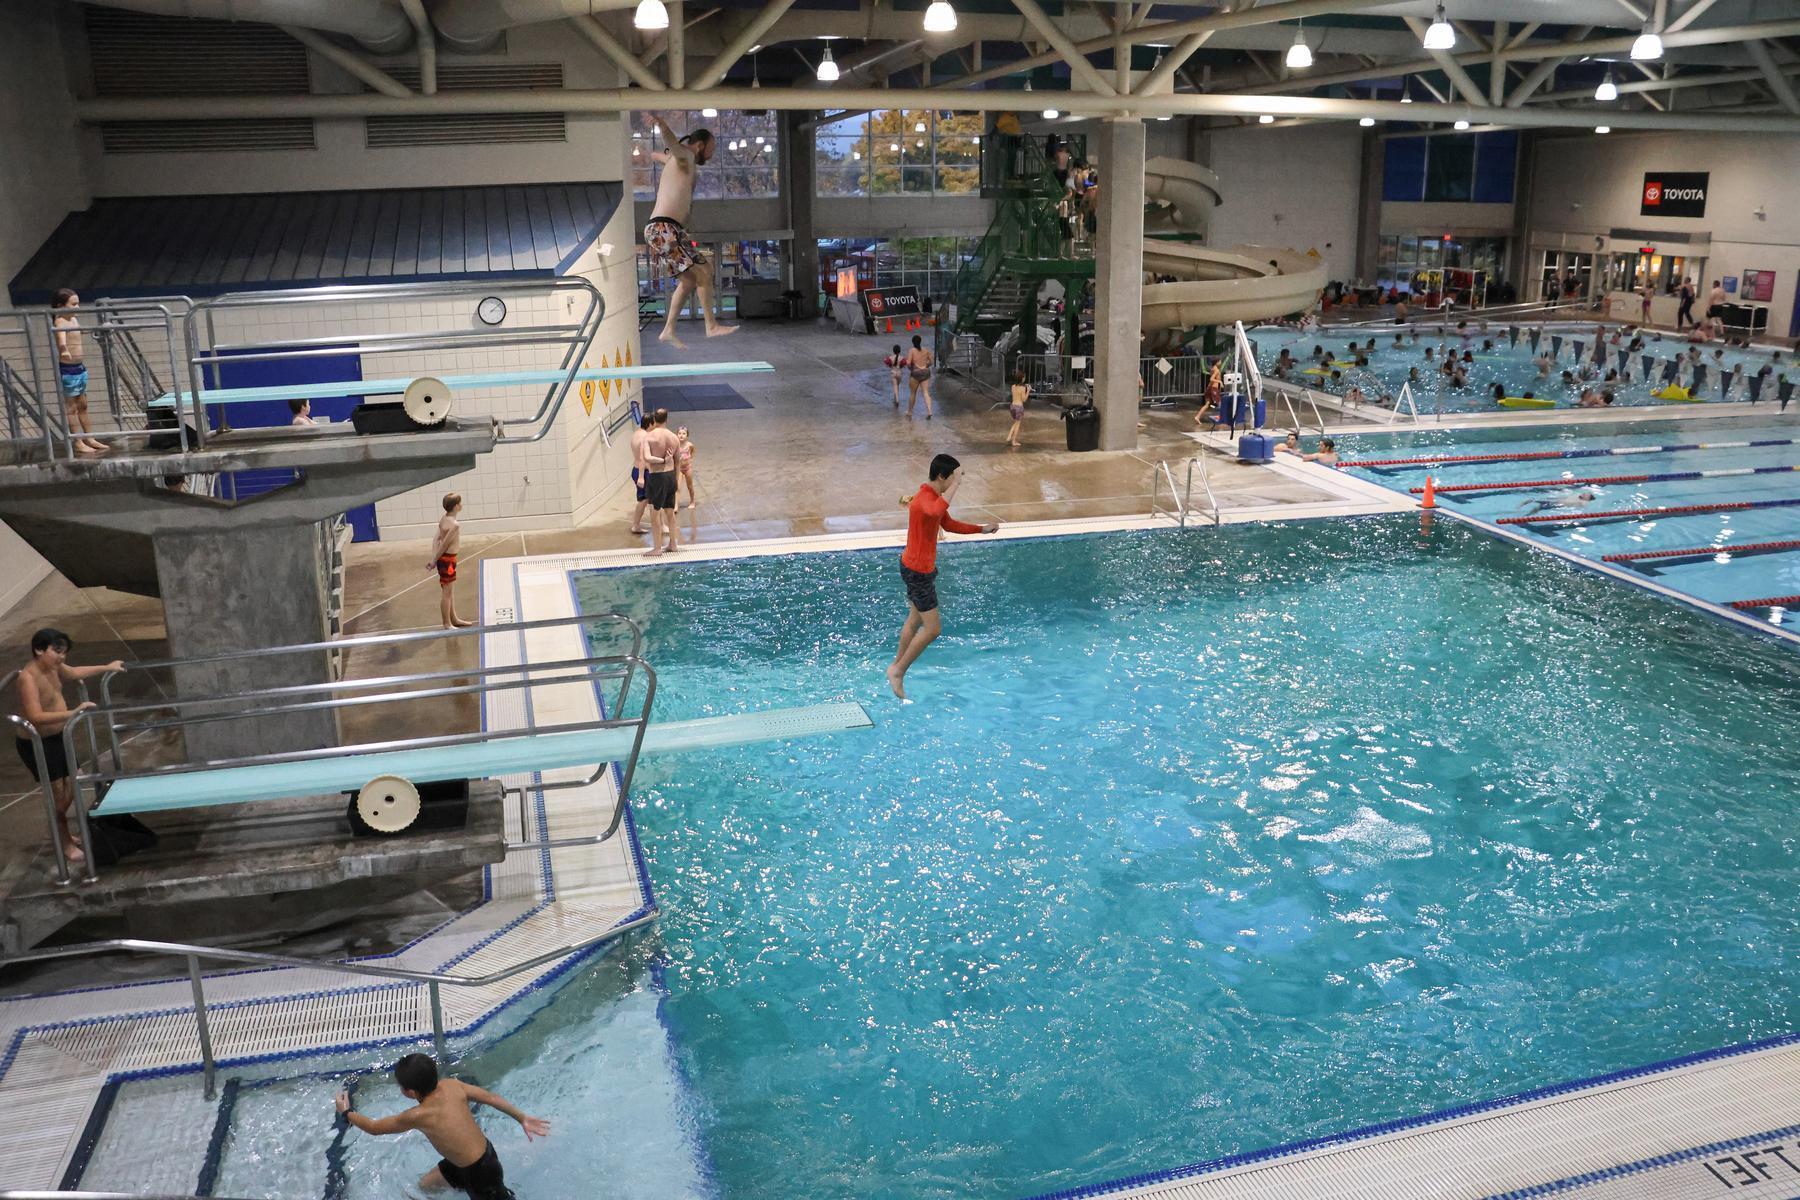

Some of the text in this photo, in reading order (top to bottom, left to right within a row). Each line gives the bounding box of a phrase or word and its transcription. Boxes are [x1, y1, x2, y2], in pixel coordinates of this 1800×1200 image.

[1664, 188, 1704, 200] TOYOTA
[885, 295, 916, 306] TOYOTA
[1703, 1146, 1800, 1189] 13FT
